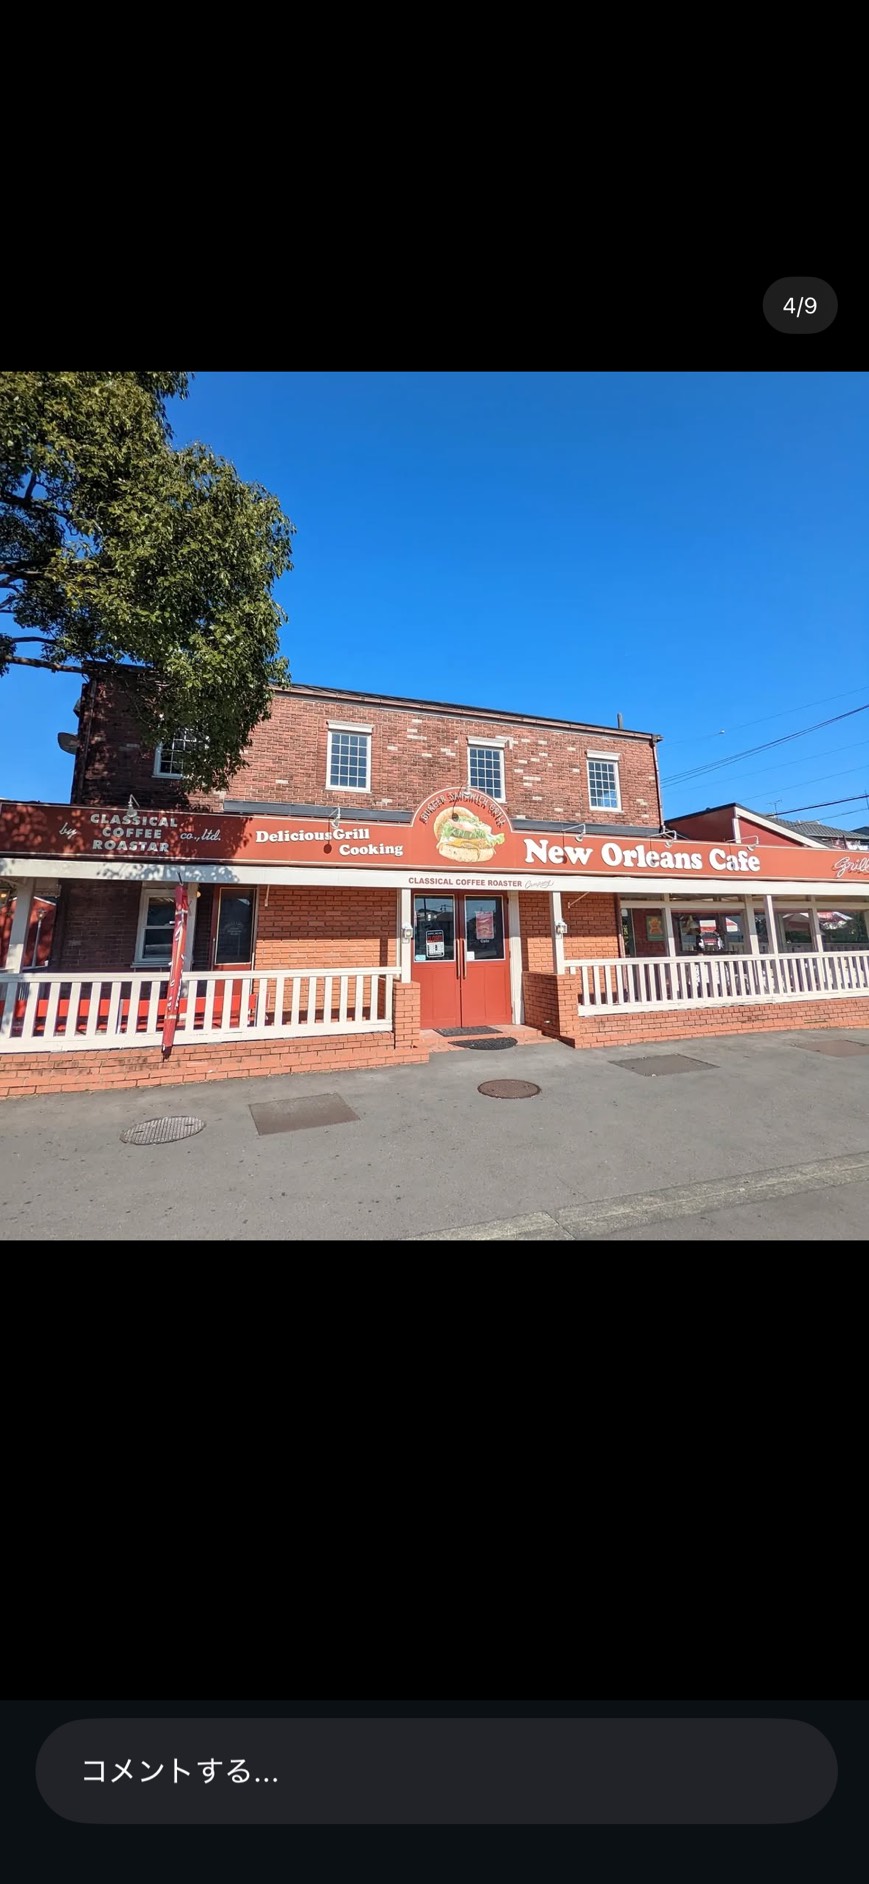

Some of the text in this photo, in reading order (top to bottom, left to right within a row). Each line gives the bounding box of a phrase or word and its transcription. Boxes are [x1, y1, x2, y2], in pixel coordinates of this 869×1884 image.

[420, 794, 447, 822] BURGER
[489, 803, 508, 825] GRILL
[90, 813, 178, 828] CLASSICAL
[59, 822, 78, 840] by
[102, 827, 162, 839] COFFEE
[92, 839, 170, 853] ROASTAR
[339, 843, 404, 857] Cooking
[523, 838, 761, 873] New Orleans Cafe
[408, 877, 454, 886] CLASSICAL
[455, 878, 486, 887] COFFEE
[487, 879, 523, 888] ROASTER
